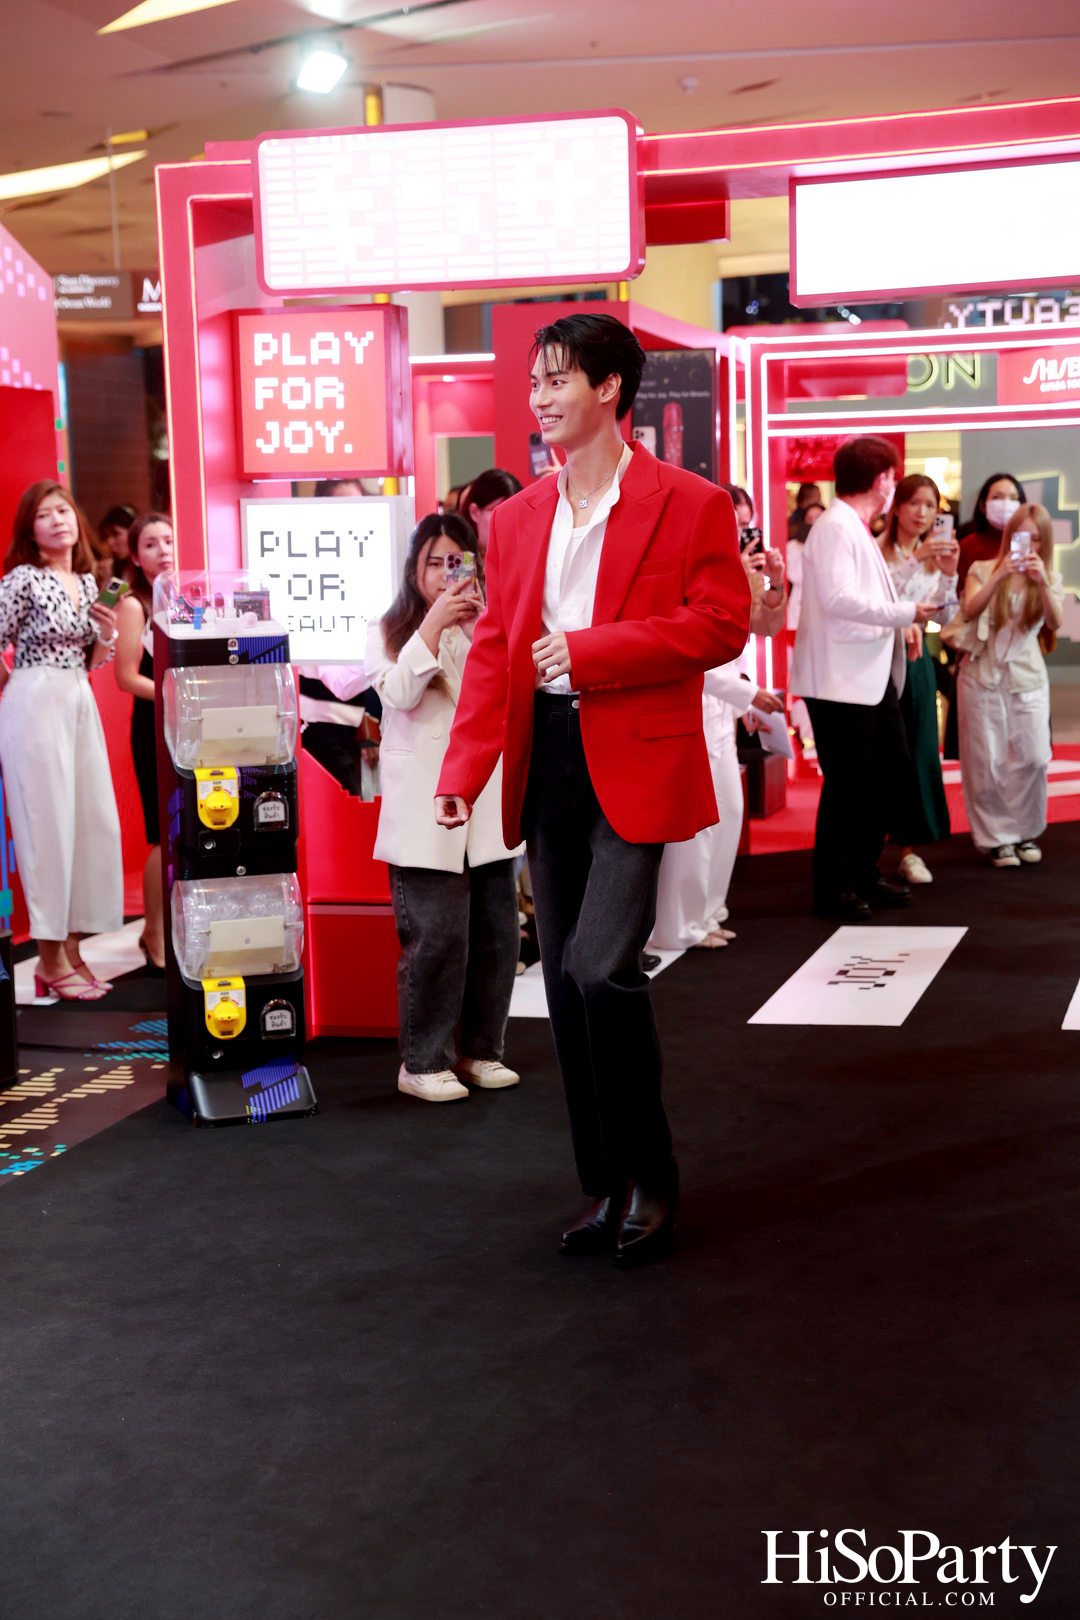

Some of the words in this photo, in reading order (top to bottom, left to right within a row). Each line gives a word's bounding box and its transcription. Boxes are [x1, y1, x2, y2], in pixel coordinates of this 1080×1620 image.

[253, 331, 375, 366] PLAY
[254, 376, 345, 410] FOR
[255, 420, 353, 454] JOY.
[259, 530, 374, 558] PLAY
[286, 615, 368, 633] EAUT
